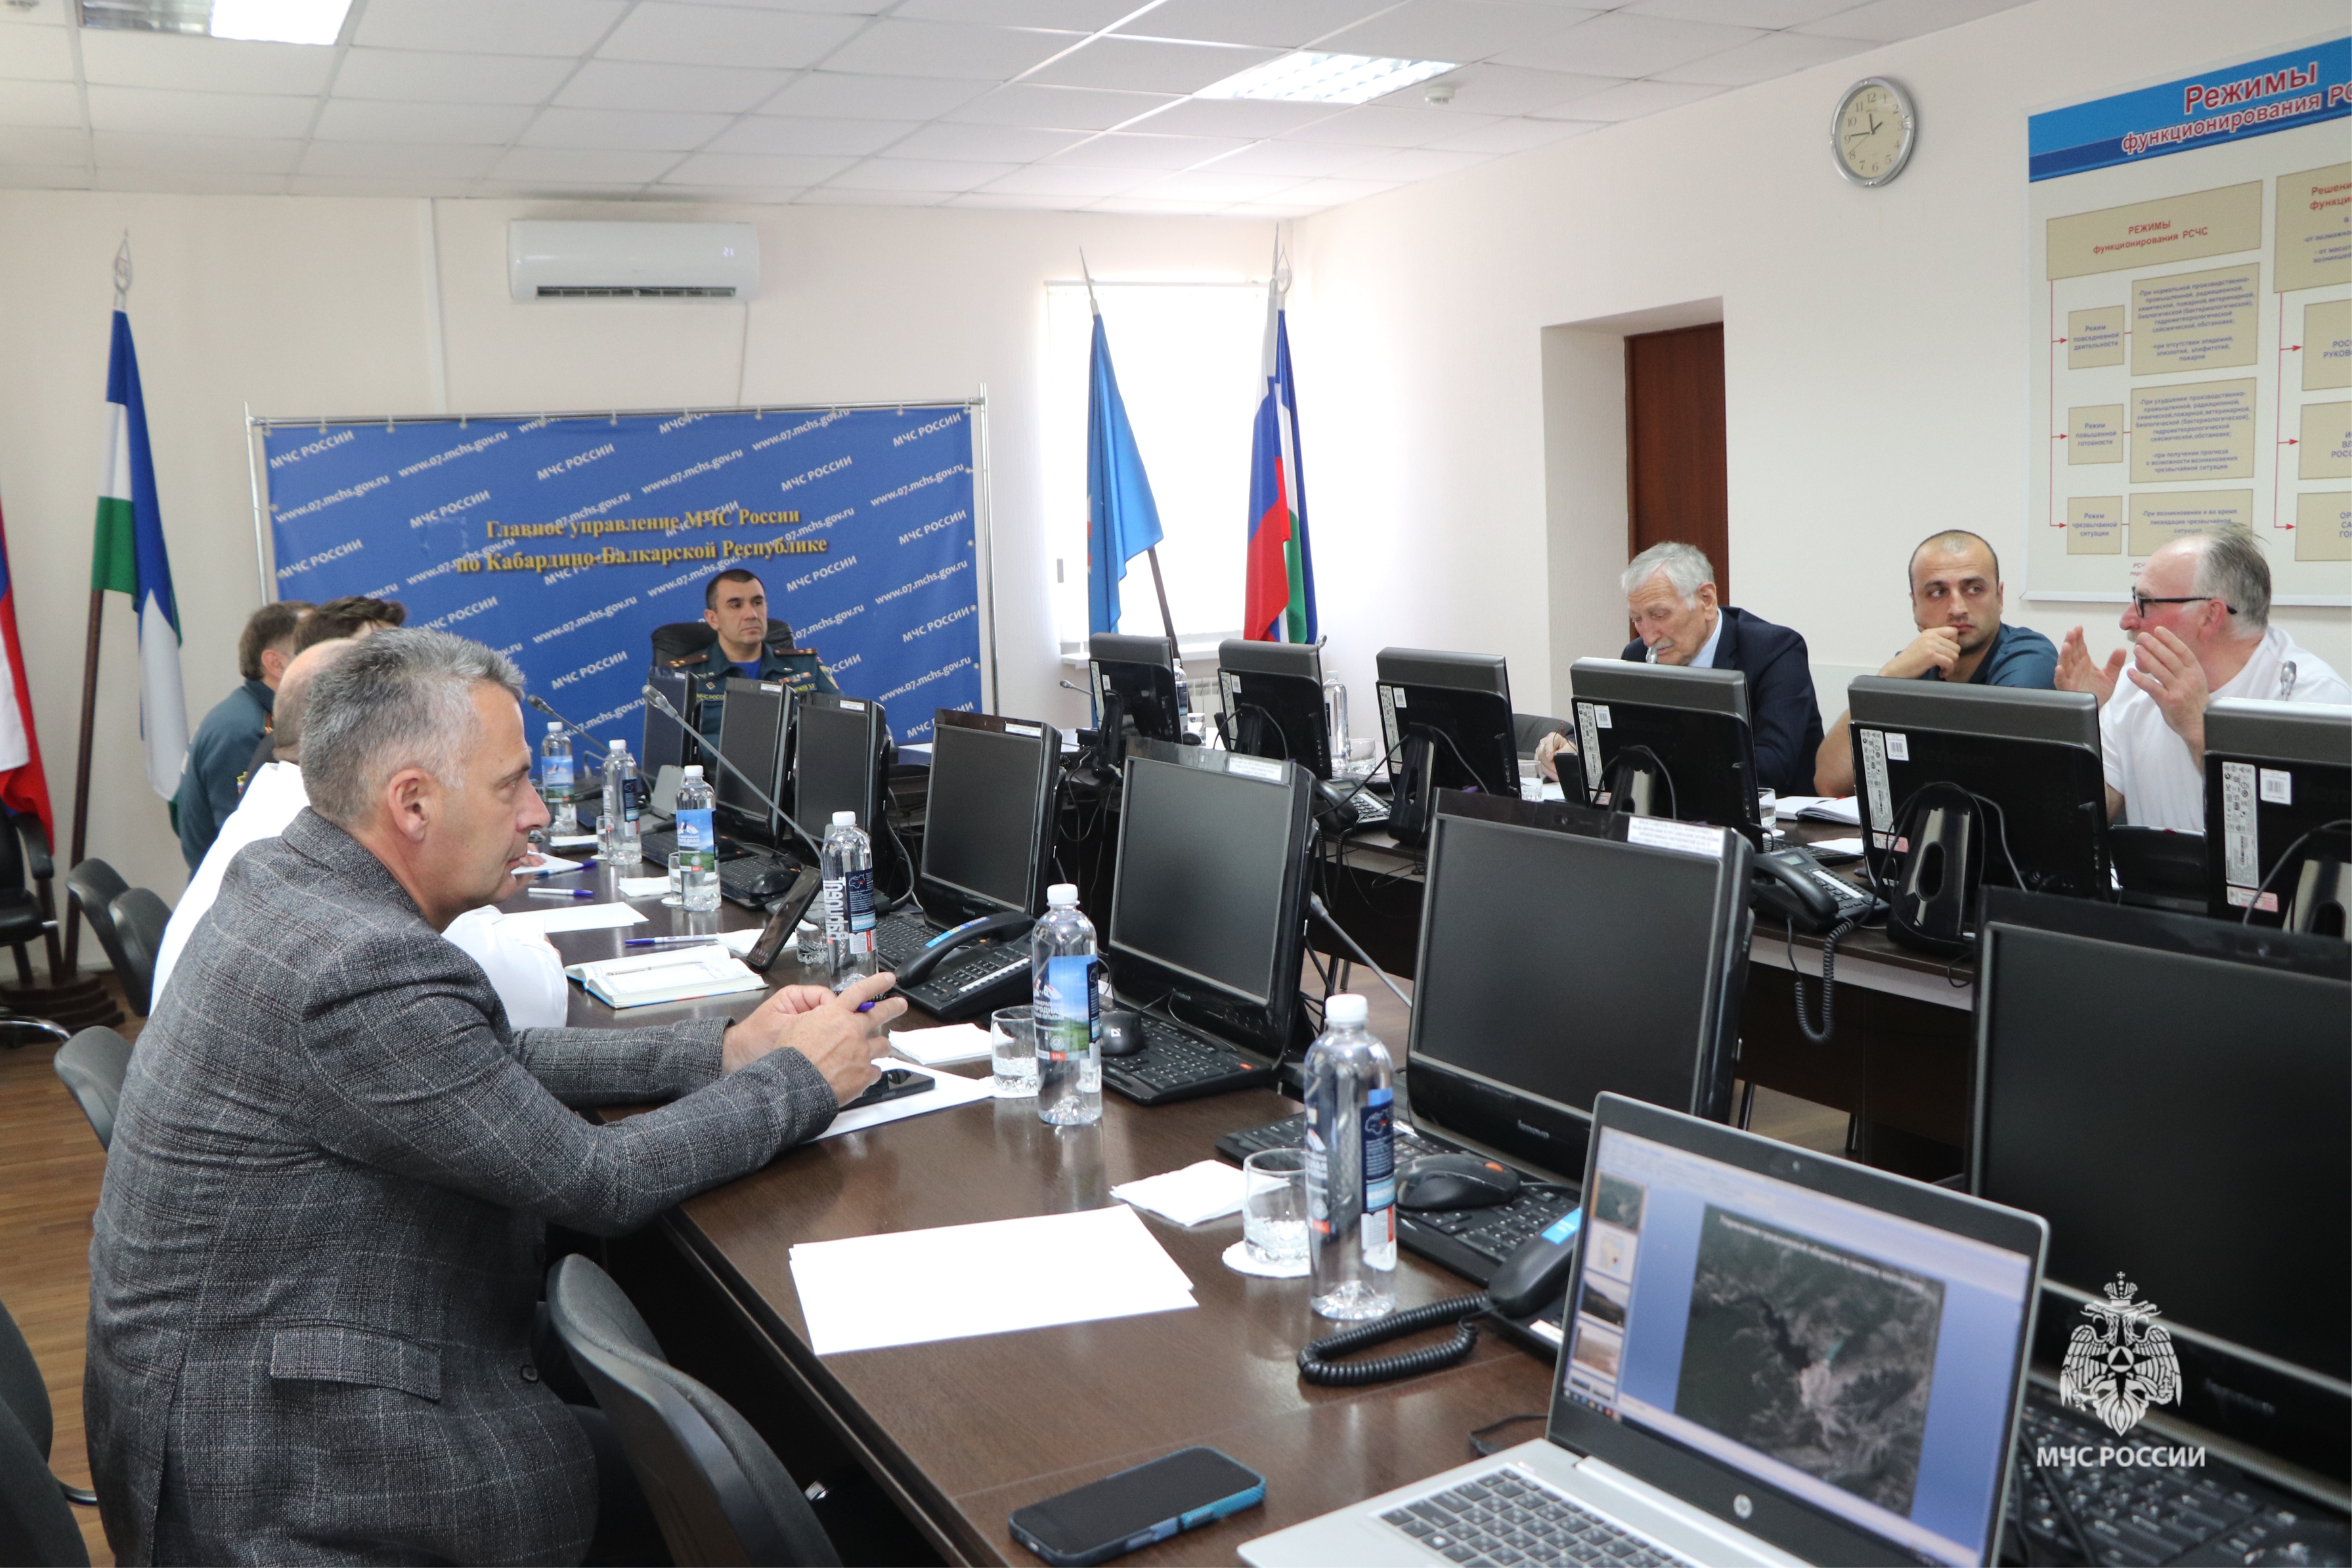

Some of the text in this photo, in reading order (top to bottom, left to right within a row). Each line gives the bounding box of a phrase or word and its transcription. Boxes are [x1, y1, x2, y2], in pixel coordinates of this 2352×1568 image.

[1867, 93, 1876, 103] 12
[1884, 94, 1886, 103] 1
[2183, 62, 2318, 115] Режимы
[1856, 101, 1863, 112] 11
[1893, 104, 1899, 114] 2
[1848, 117, 1857, 127] 10
[1898, 120, 1904, 131] 3
[2122, 94, 2322, 155] функционирования
[1844, 135, 1851, 144] 9
[1894, 140, 1900, 149] 4
[1849, 150, 1856, 160] 8
[1860, 160, 1865, 171] 7
[1872, 162, 1879, 172] 6
[1885, 154, 1892, 164] 5
[2093, 227, 2208, 255] функционирования РСЧС
[2128, 220, 2171, 235] РЕЖИМЫ
[2073, 332, 2119, 342] повседневной
[2074, 341, 2118, 351] деятельности
[2166, 340, 2200, 349] отсутствии
[2154, 396, 2187, 405] ухудшении
[659, 416, 686, 434] МЧС
[893, 412, 961, 446] МЧС РОССИИ
[270, 429, 355, 469] МЧС РОССИИ
[398, 431, 509, 477] www.07.mchs.gov.ru
[536, 443, 615, 480] МЧС РОССИИ
[2167, 450, 2199, 458] получении
[642, 449, 743, 494] www.07.mchs.gov.ru
[781, 456, 852, 492] МЧС РОССИИ
[870, 463, 965, 506] www.07.mchs.gov.ru
[276, 475, 391, 523] www.07.mchs.gov.ru
[410, 490, 490, 528] МЧС РОССИИ
[555, 492, 631, 526] 07.mchs.gov.ru
[486, 508, 800, 539] Главное управление МЧС России
[899, 510, 967, 546] МЧС РОССИИ
[280, 538, 364, 578] МЧС РОССИИ
[456, 559, 481, 573] по
[487, 541, 716, 573] Кабардино-Балкарской
[722, 538, 827, 559] Республике
[544, 567, 571, 586] МЧС
[647, 555, 748, 597] www.07.mchs.gov.r
[787, 555, 858, 592] МЧС РОССИИ
[875, 560, 968, 605] www.07.mchs.gov.ru
[447, 596, 498, 623] РОССИИ
[533, 596, 638, 644] www.07.mchs.gov.ru
[793, 604, 865, 641] .07.mchs.gov.ru
[902, 606, 970, 643] МЧС РОССИИ
[552, 650, 628, 690] МЧС РОССИИ
[827, 653, 861, 675] ОССИИ
[879, 657, 971, 702] www.07.mchs.gov.ru
[907, 721, 932, 739] МЧС
